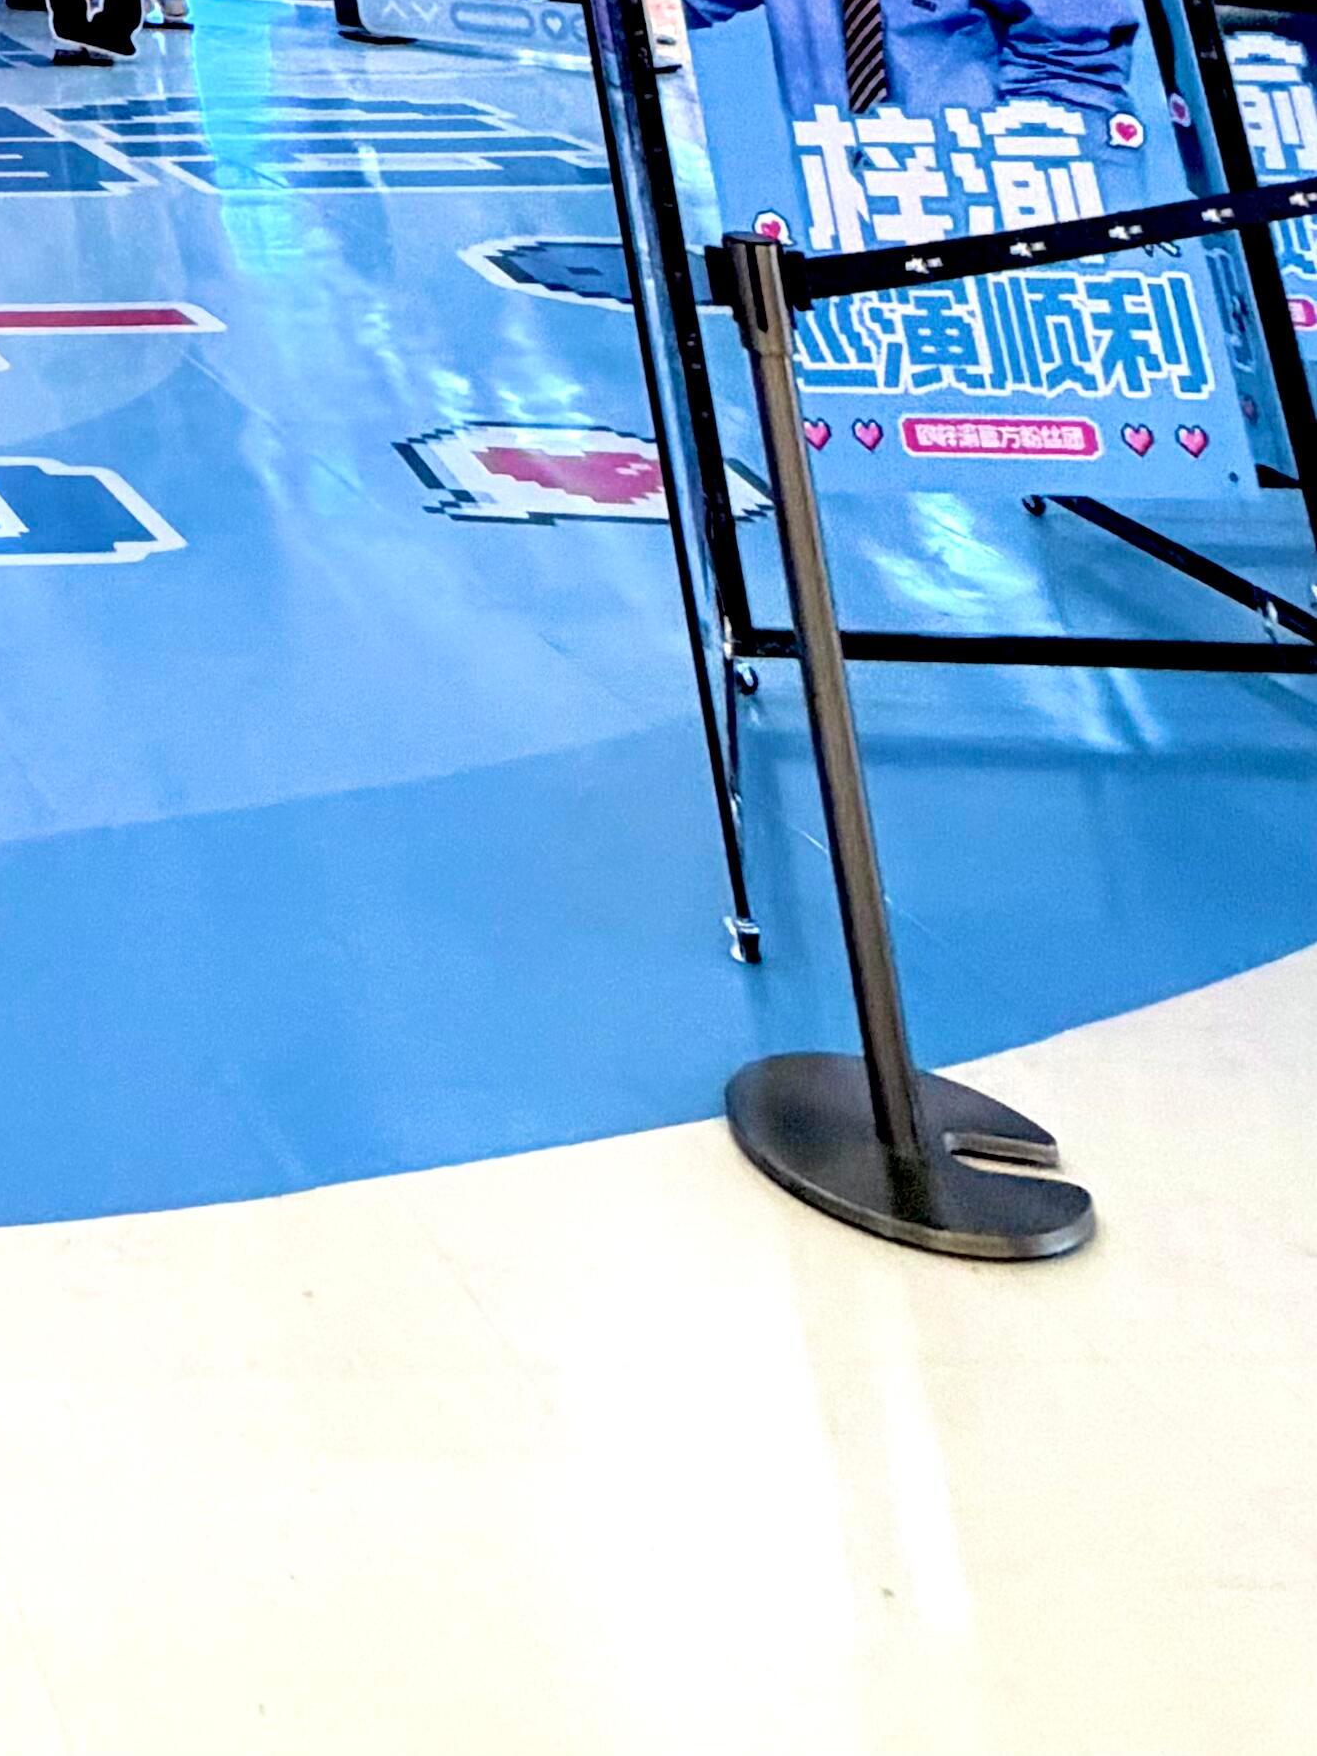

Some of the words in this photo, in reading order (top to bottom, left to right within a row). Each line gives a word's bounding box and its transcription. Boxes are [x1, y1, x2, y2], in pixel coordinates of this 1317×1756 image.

[793, 98, 1106, 263] 梓渝
[793, 271, 1214, 400] 巡演顺利
